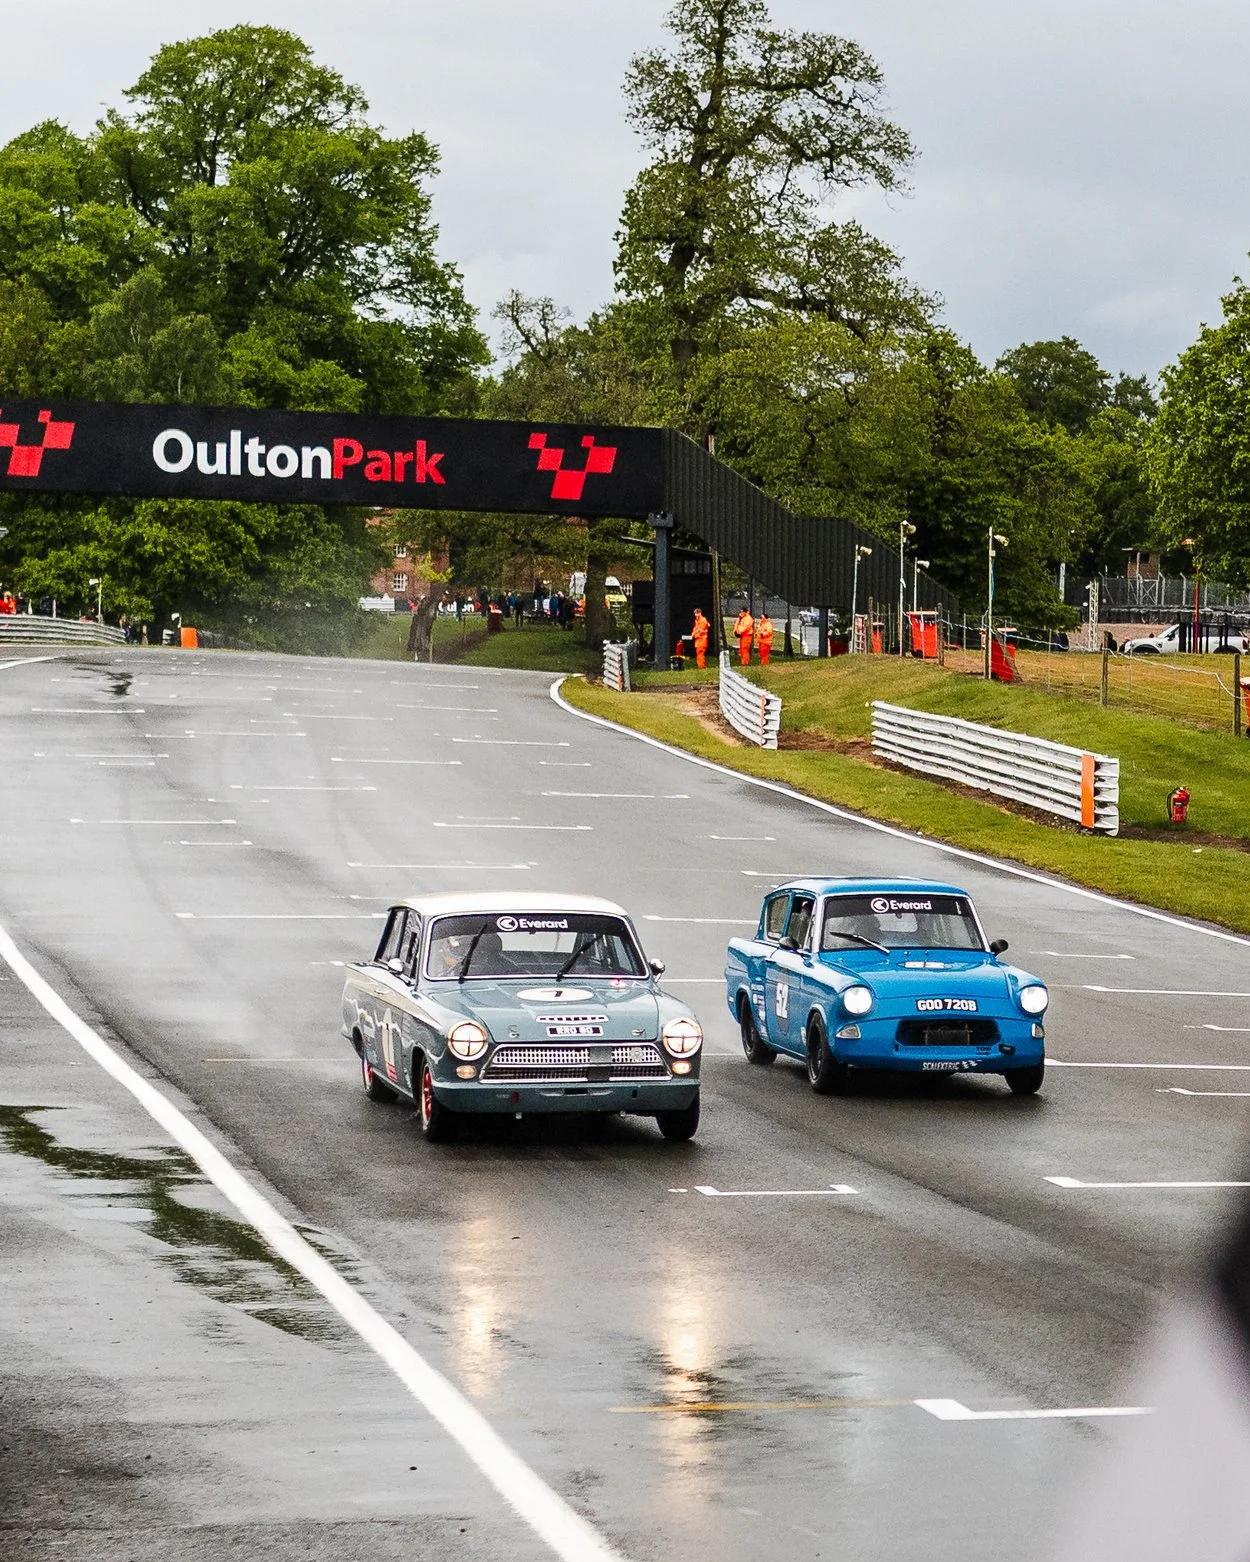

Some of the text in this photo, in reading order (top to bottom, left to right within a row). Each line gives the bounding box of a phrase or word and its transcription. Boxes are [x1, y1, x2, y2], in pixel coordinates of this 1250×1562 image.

[152, 428, 446, 485] OultonPark
[889, 900, 932, 910] Everard
[519, 919, 569, 929] Everard
[775, 982, 789, 1019] 52
[917, 998, 977, 1011] GOO 720B
[922, 1061, 960, 1071] SCALEXTRIC
